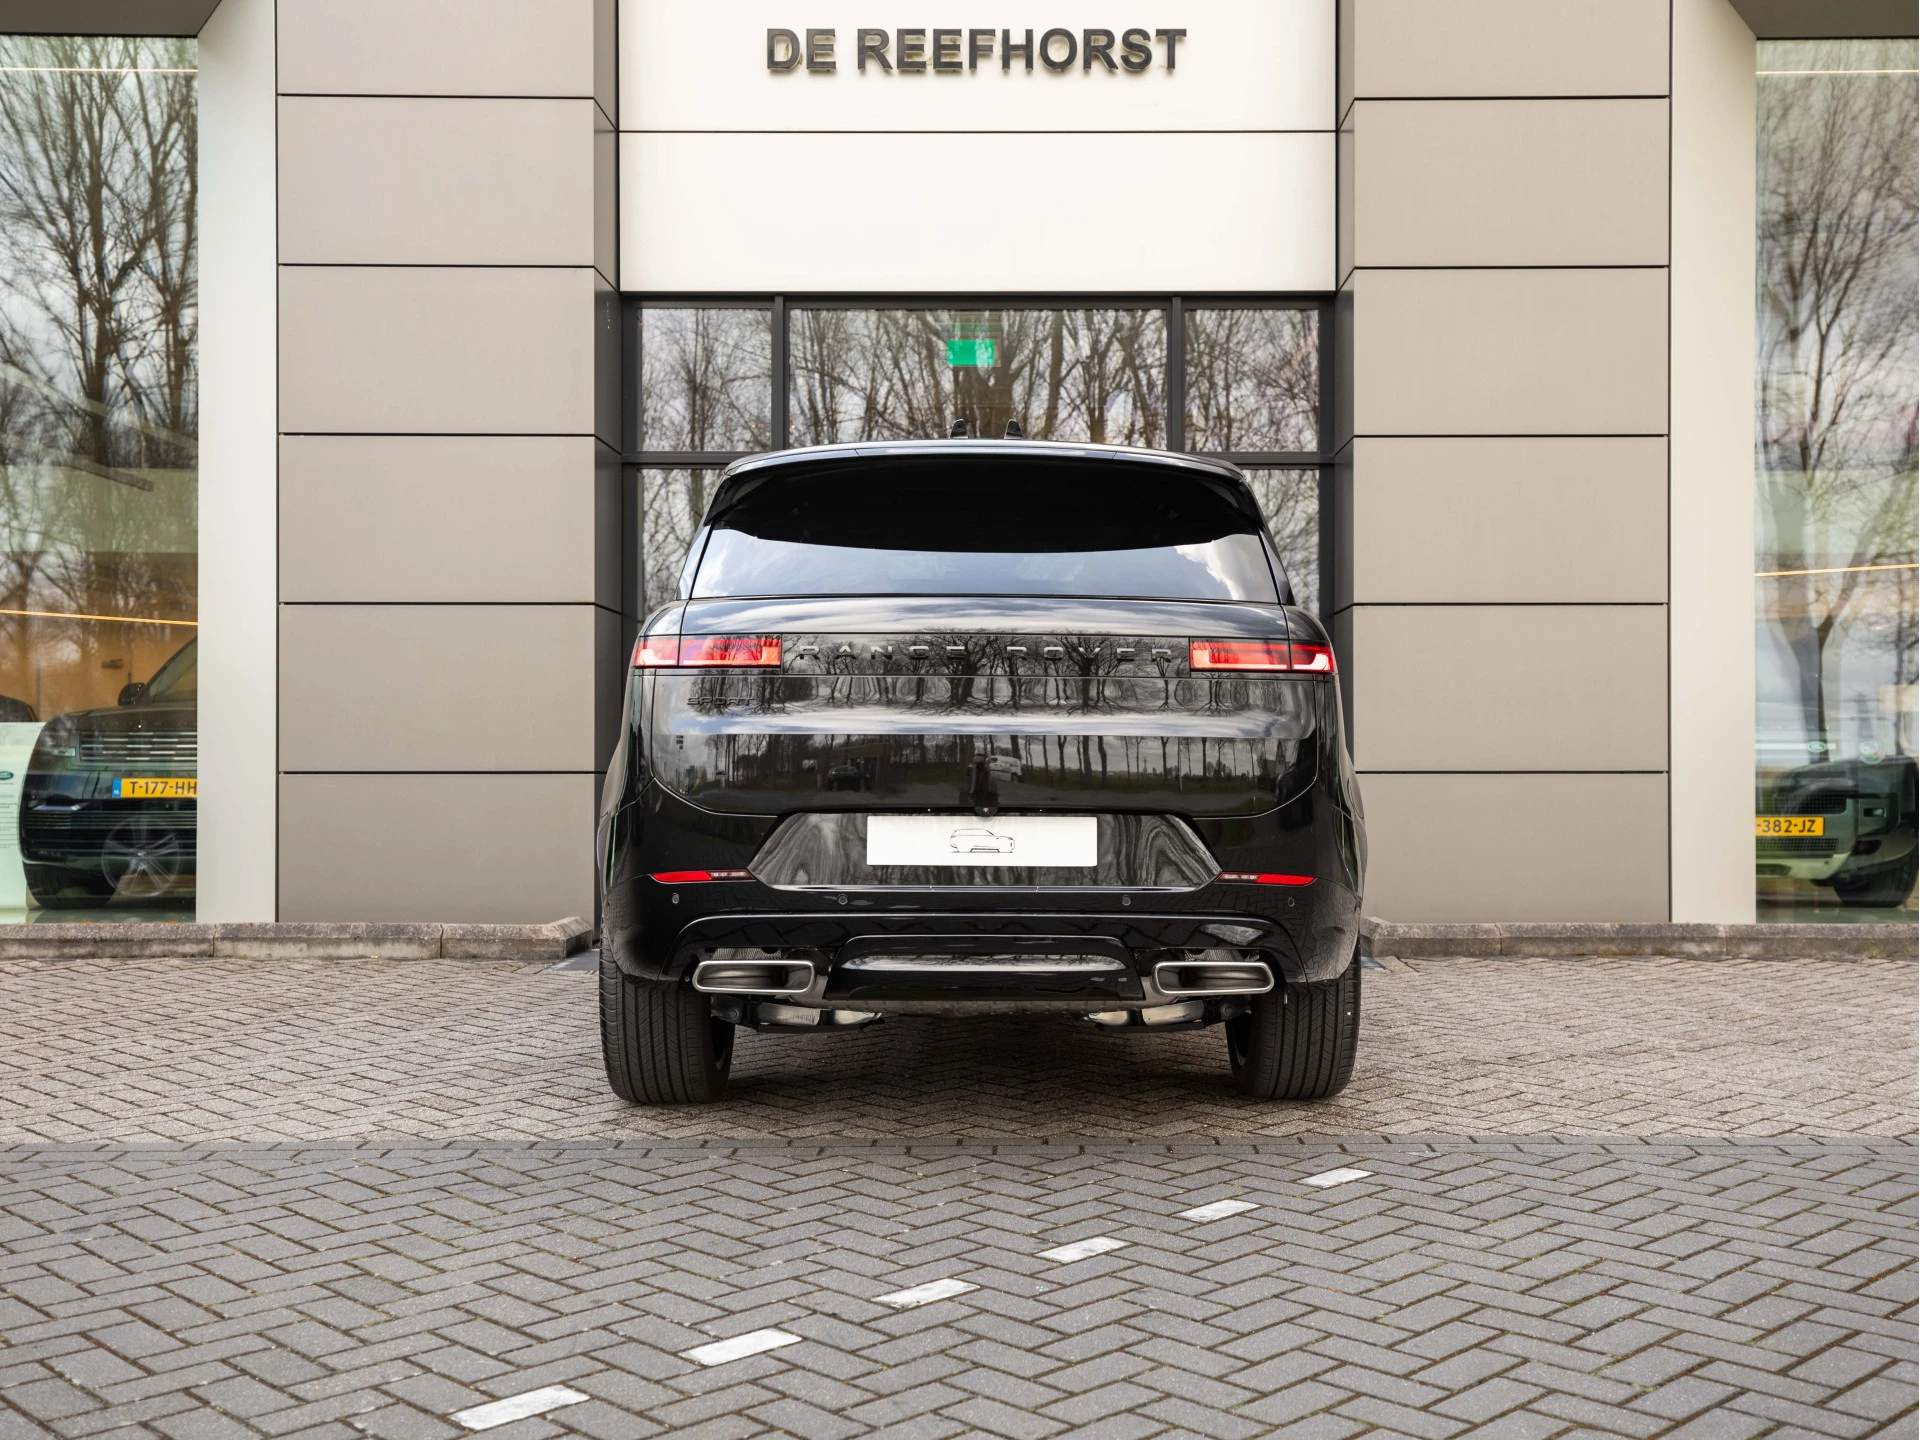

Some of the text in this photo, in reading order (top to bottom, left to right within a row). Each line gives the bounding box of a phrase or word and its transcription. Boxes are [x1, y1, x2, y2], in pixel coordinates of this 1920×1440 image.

[766, 28, 1188, 72] DE REEFHORST
[799, 645, 1172, 663] RANGE ROVER
[687, 696, 755, 706] SPORT
[129, 781, 197, 795] T-177-HH
